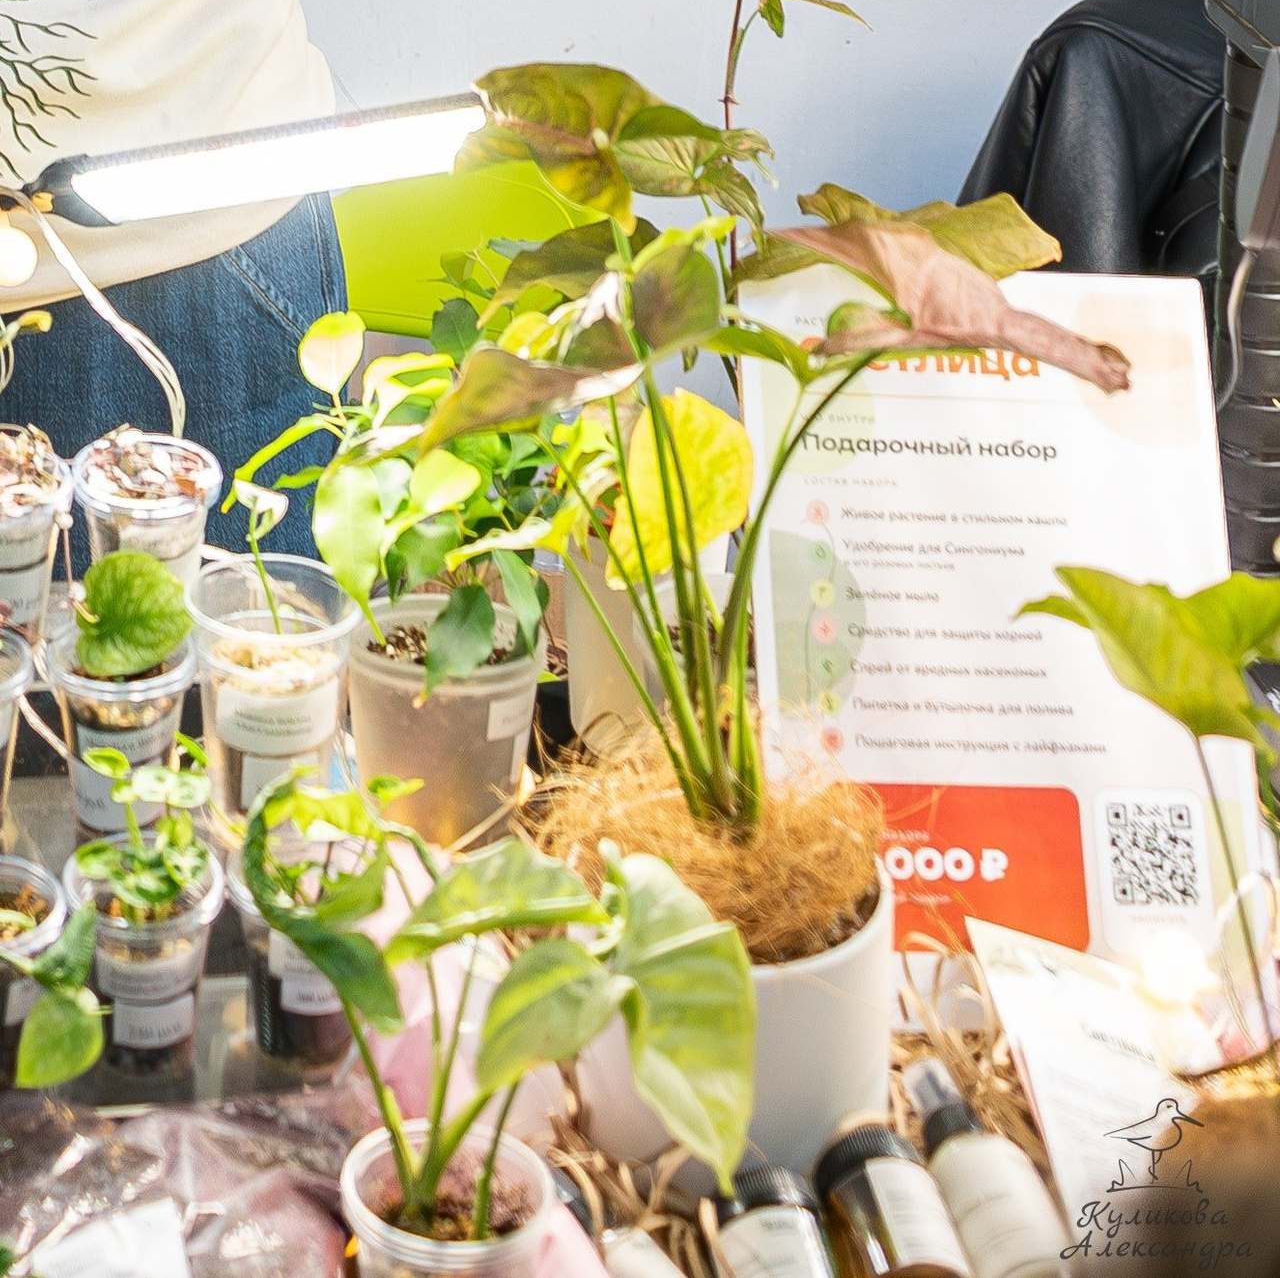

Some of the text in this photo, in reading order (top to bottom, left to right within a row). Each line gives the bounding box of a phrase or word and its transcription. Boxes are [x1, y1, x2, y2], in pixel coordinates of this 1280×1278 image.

[802, 431, 1058, 462] Подарочный набор
[841, 506, 885, 522] Живое
[889, 510, 947, 524] растение
[918, 543, 941, 556] для
[848, 622, 910, 639] Средство
[914, 628, 937, 640] для
[884, 845, 975, 882] 000
